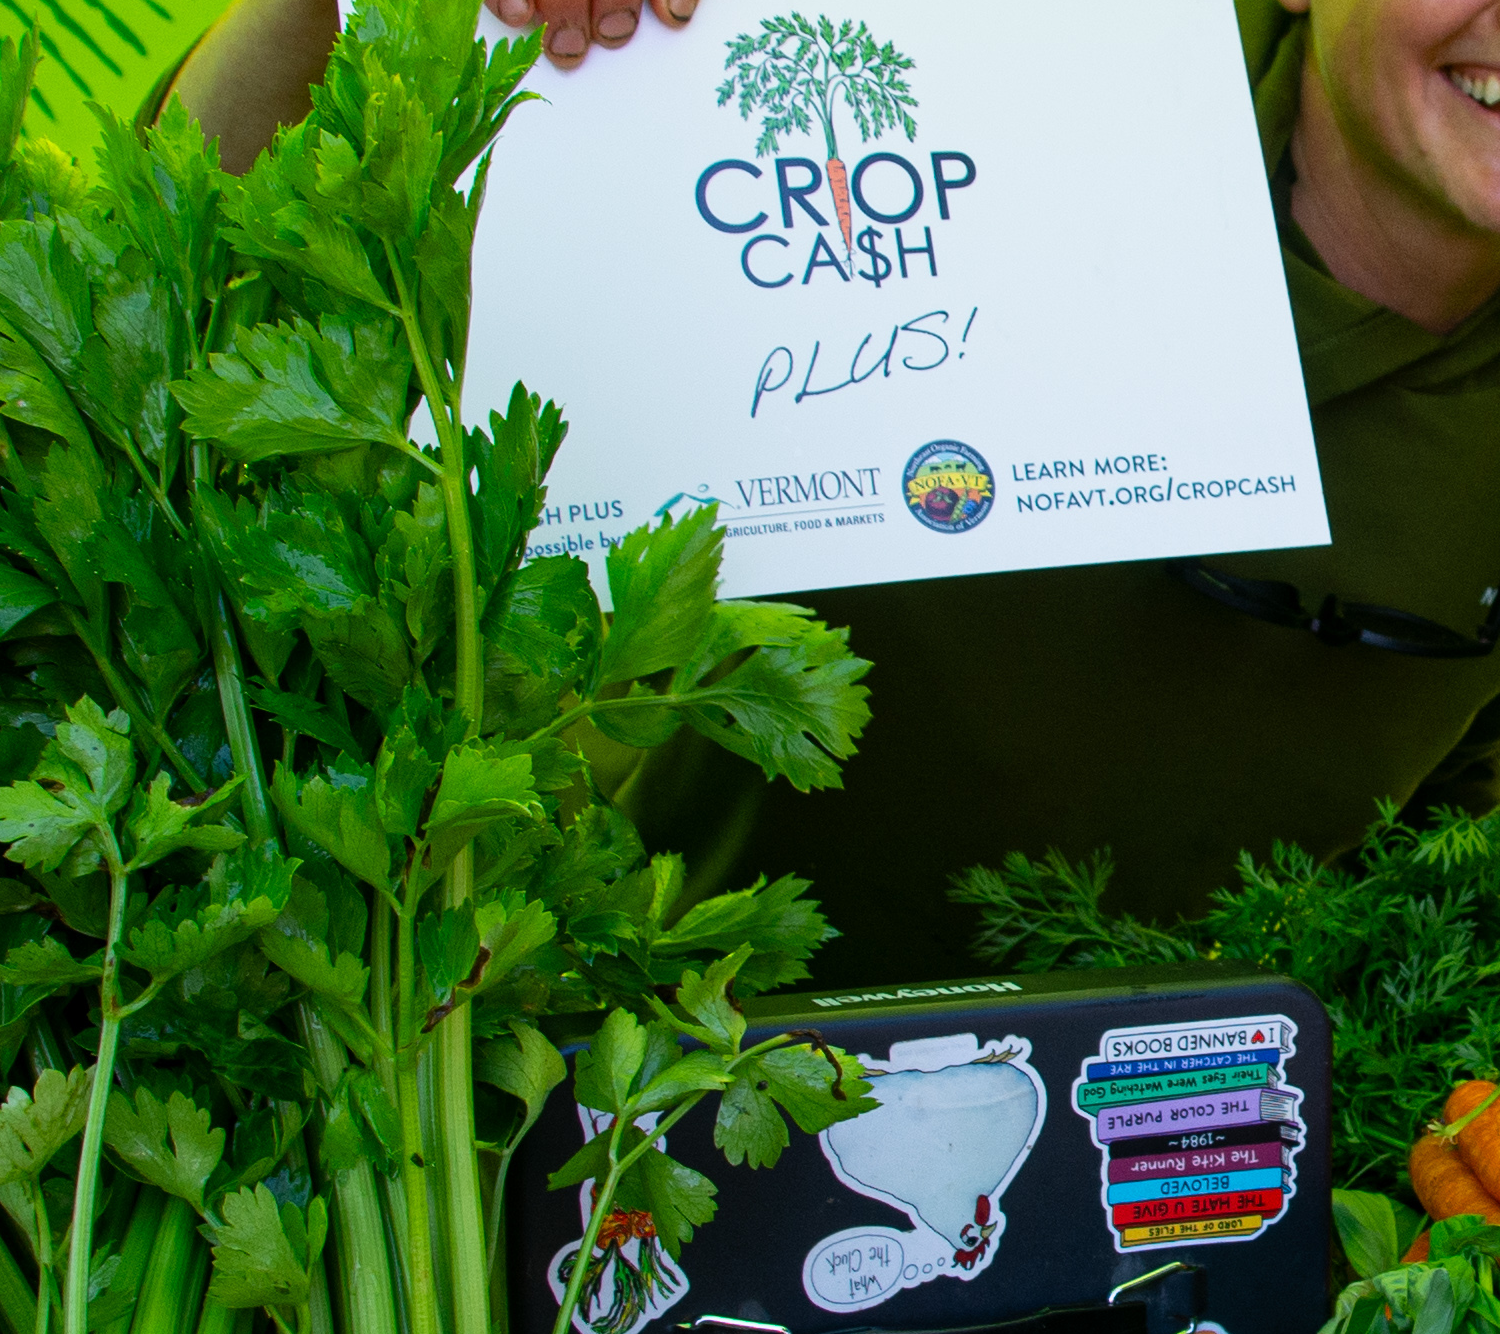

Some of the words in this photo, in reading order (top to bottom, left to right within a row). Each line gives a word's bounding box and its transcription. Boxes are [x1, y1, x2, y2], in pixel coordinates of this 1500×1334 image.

[694, 150, 977, 234] CROP
[740, 224, 938, 289] CA$H
[749, 306, 978, 419] PLUS!
[1011, 459, 1086, 482] LEARN
[1094, 454, 1168, 476] MORE:
[735, 467, 882, 507] VERMONT
[1016, 475, 1297, 513] NOFAVT.ORG/CROPCASH
[568, 499, 624, 523] PLUS
[724, 521, 792, 539] GRICULTURE,
[794, 518, 822, 532] FOOD
[824, 517, 833, 528] &
[835, 513, 886, 527] MARKETS
[524, 533, 594, 564] possible
[811, 981, 1024, 1007] Honeywell
[1112, 1036, 1173, 1057] BOOKS
[1176, 1030, 1248, 1052] BANNED
[1163, 1059, 1177, 1070] IN
[1180, 1053, 1232, 1069] CATCHER
[1236, 1052, 1258, 1063] THE
[1109, 1062, 1133, 1076] RYE
[1136, 1061, 1160, 1073] THE
[1166, 1076, 1198, 1091] Were
[1202, 1071, 1228, 1087] Eyes
[1231, 1069, 1263, 1086] Their
[1083, 1086, 1107, 1102] God
[1110, 1078, 1163, 1100] Watching
[1169, 1104, 1216, 1122] COLOR
[1220, 1099, 1250, 1116] THE
[1106, 1110, 1163, 1130] PURPLE
[1130, 1155, 1186, 1172] Runner
[1191, 1151, 1226, 1169] Kite
[1230, 1148, 1259, 1165] The
[1159, 1174, 1230, 1196] BELOVED
[1132, 1201, 1169, 1220] GIVE
[1173, 1201, 1185, 1216] U
[1191, 1195, 1231, 1214] HATE
[1237, 1193, 1266, 1210] THE
[1148, 1224, 1175, 1237] FLIES
[1179, 1223, 1199, 1235] THE
[1202, 1221, 1215, 1233] OF
[1216, 1218, 1243, 1232] LORD
[825, 1248, 863, 1276] Cluck
[868, 1244, 891, 1267] the
[849, 1274, 882, 1299] What
